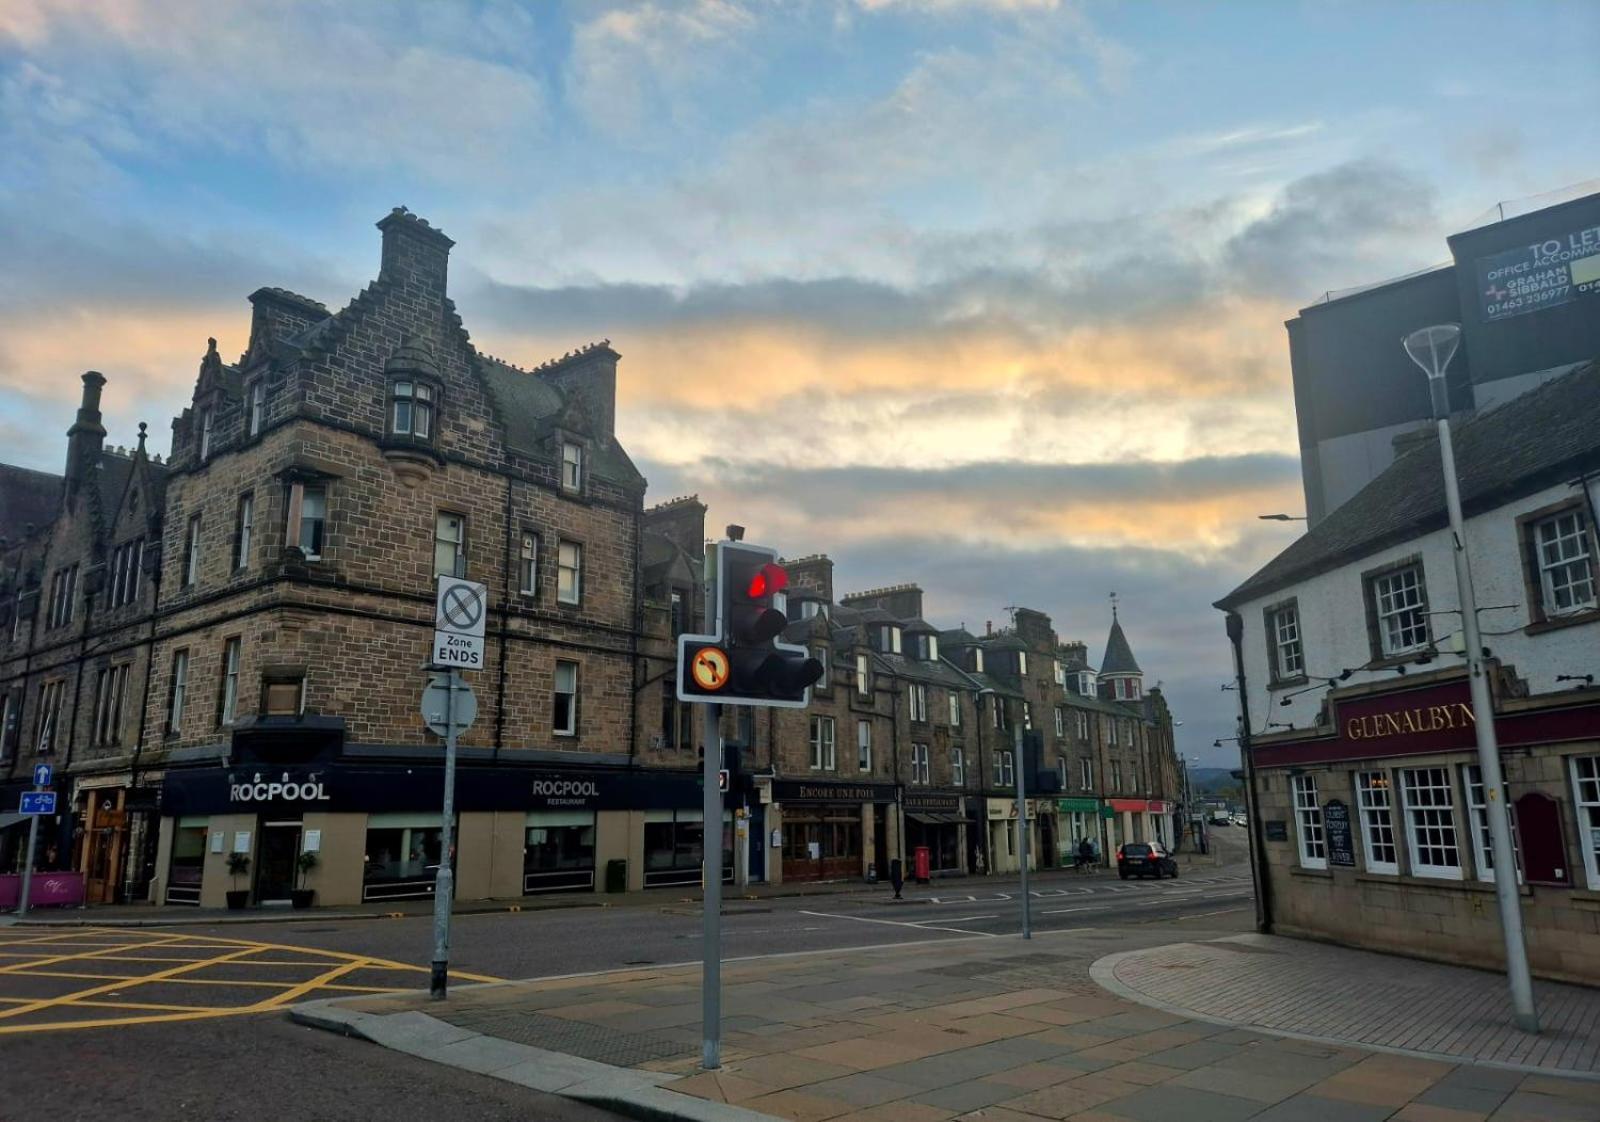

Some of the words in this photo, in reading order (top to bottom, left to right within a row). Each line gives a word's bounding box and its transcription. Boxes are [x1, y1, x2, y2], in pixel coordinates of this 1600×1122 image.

[1528, 239, 1561, 259] TO
[1487, 261, 1530, 280] OFFICE
[1506, 266, 1567, 289] GRAHAM
[1508, 275, 1568, 298] SIBBALD
[447, 635, 473, 648] Zone
[439, 647, 479, 664] ENDS
[1346, 702, 1477, 740] GLENALBYN
[229, 782, 331, 803] ROCPOOL
[532, 780, 600, 797] ROCPOOL
